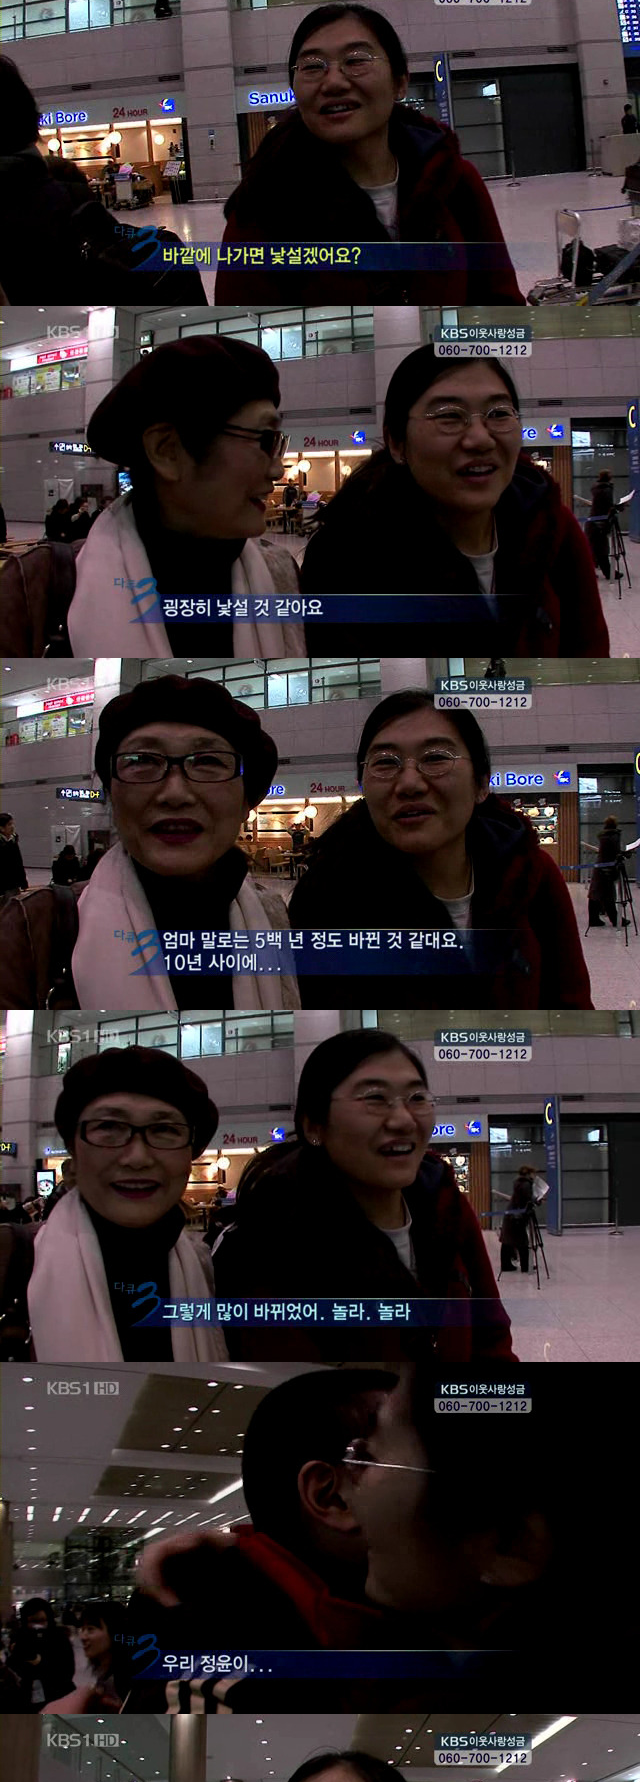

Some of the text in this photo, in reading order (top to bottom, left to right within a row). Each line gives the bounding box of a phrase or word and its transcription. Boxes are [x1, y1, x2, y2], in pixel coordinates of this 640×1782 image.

[435, 60, 443, 82] C
[248, 88, 296, 105] Sanuk
[55, 110, 87, 124] Bore
[112, 107, 148, 118] 24 HOUR
[628, 405, 636, 428] C
[303, 436, 316, 447] 24
[505, 772, 544, 787] Bore
[310, 782, 346, 793] 24 HOUR
[545, 1102, 553, 1124] C
[223, 1133, 258, 1145] 24 HOUR
